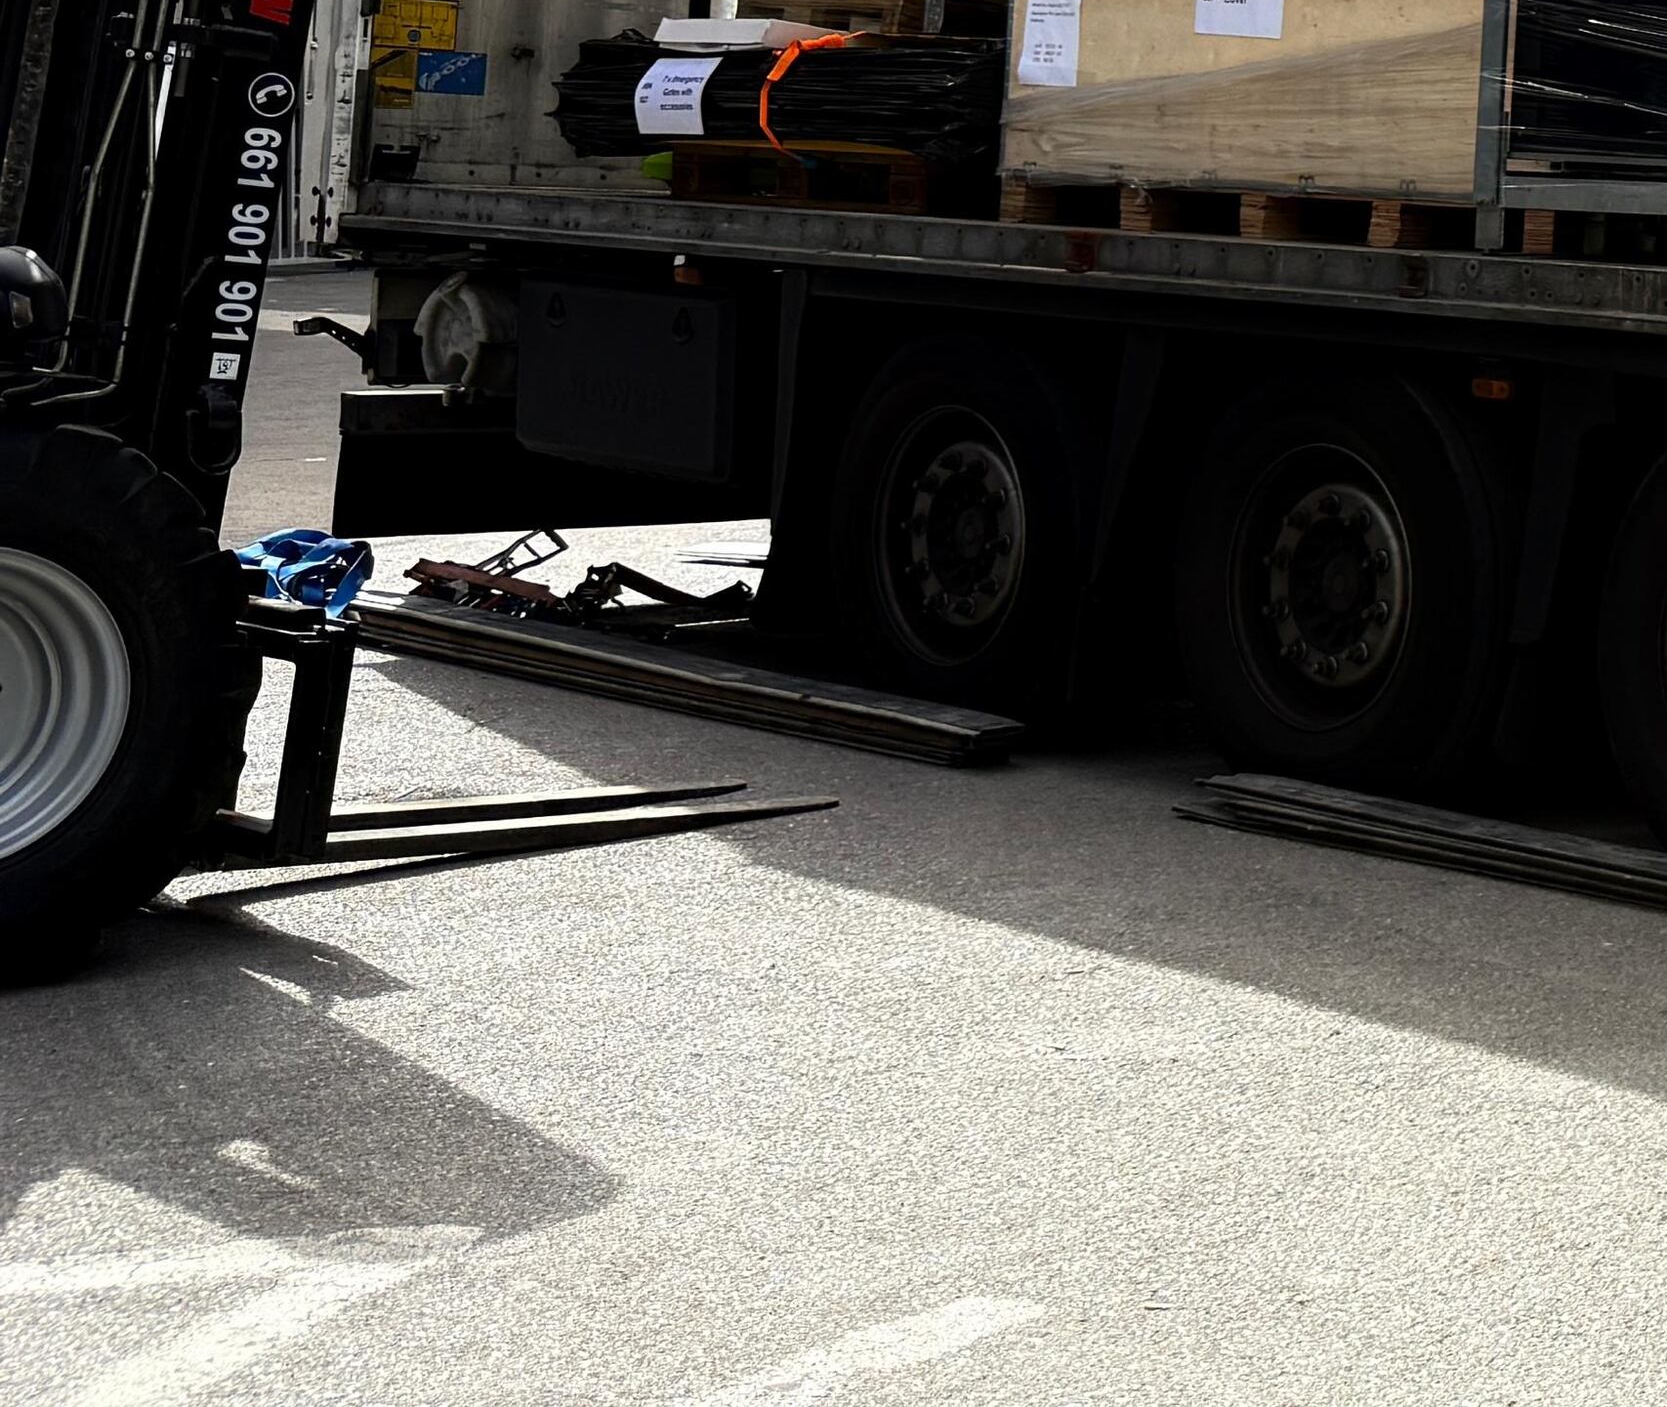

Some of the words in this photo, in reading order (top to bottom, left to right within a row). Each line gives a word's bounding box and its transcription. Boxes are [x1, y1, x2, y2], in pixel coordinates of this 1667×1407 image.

[236, 127, 282, 188] 661
[224, 203, 269, 265] 901
[211, 280, 256, 342] 901
